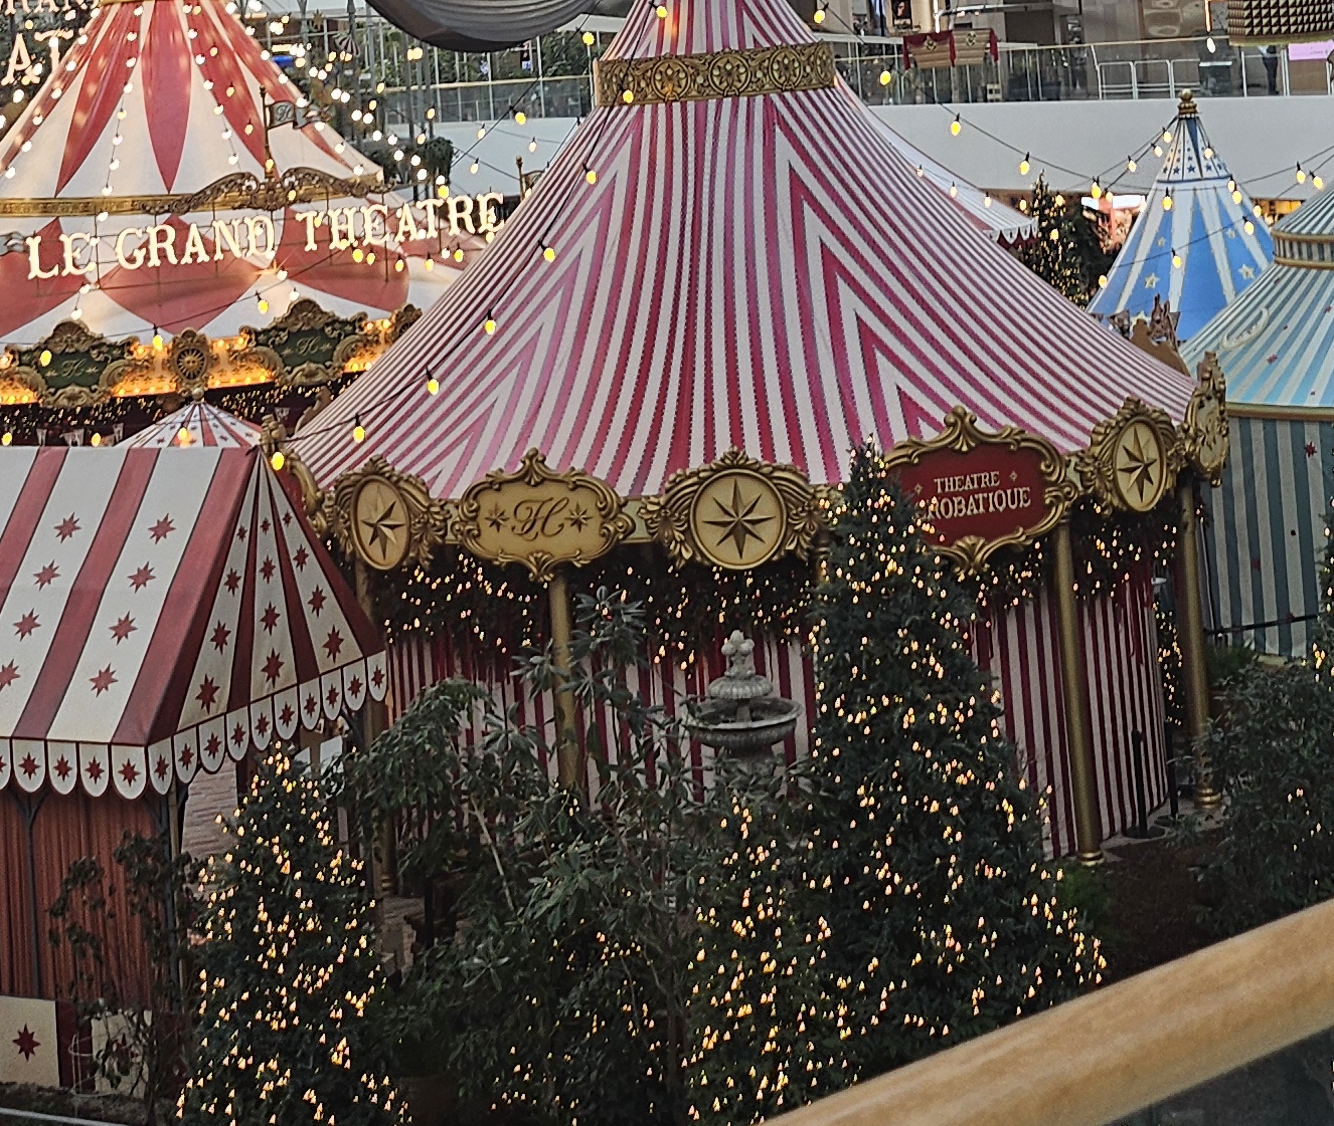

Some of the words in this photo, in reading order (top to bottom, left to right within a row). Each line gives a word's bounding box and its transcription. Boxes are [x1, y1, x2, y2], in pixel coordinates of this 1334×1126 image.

[25, 230, 97, 279] LE
[113, 214, 275, 270] GRAND
[295, 192, 506, 252] THEATRE
[933, 471, 1001, 494] THEATRE
